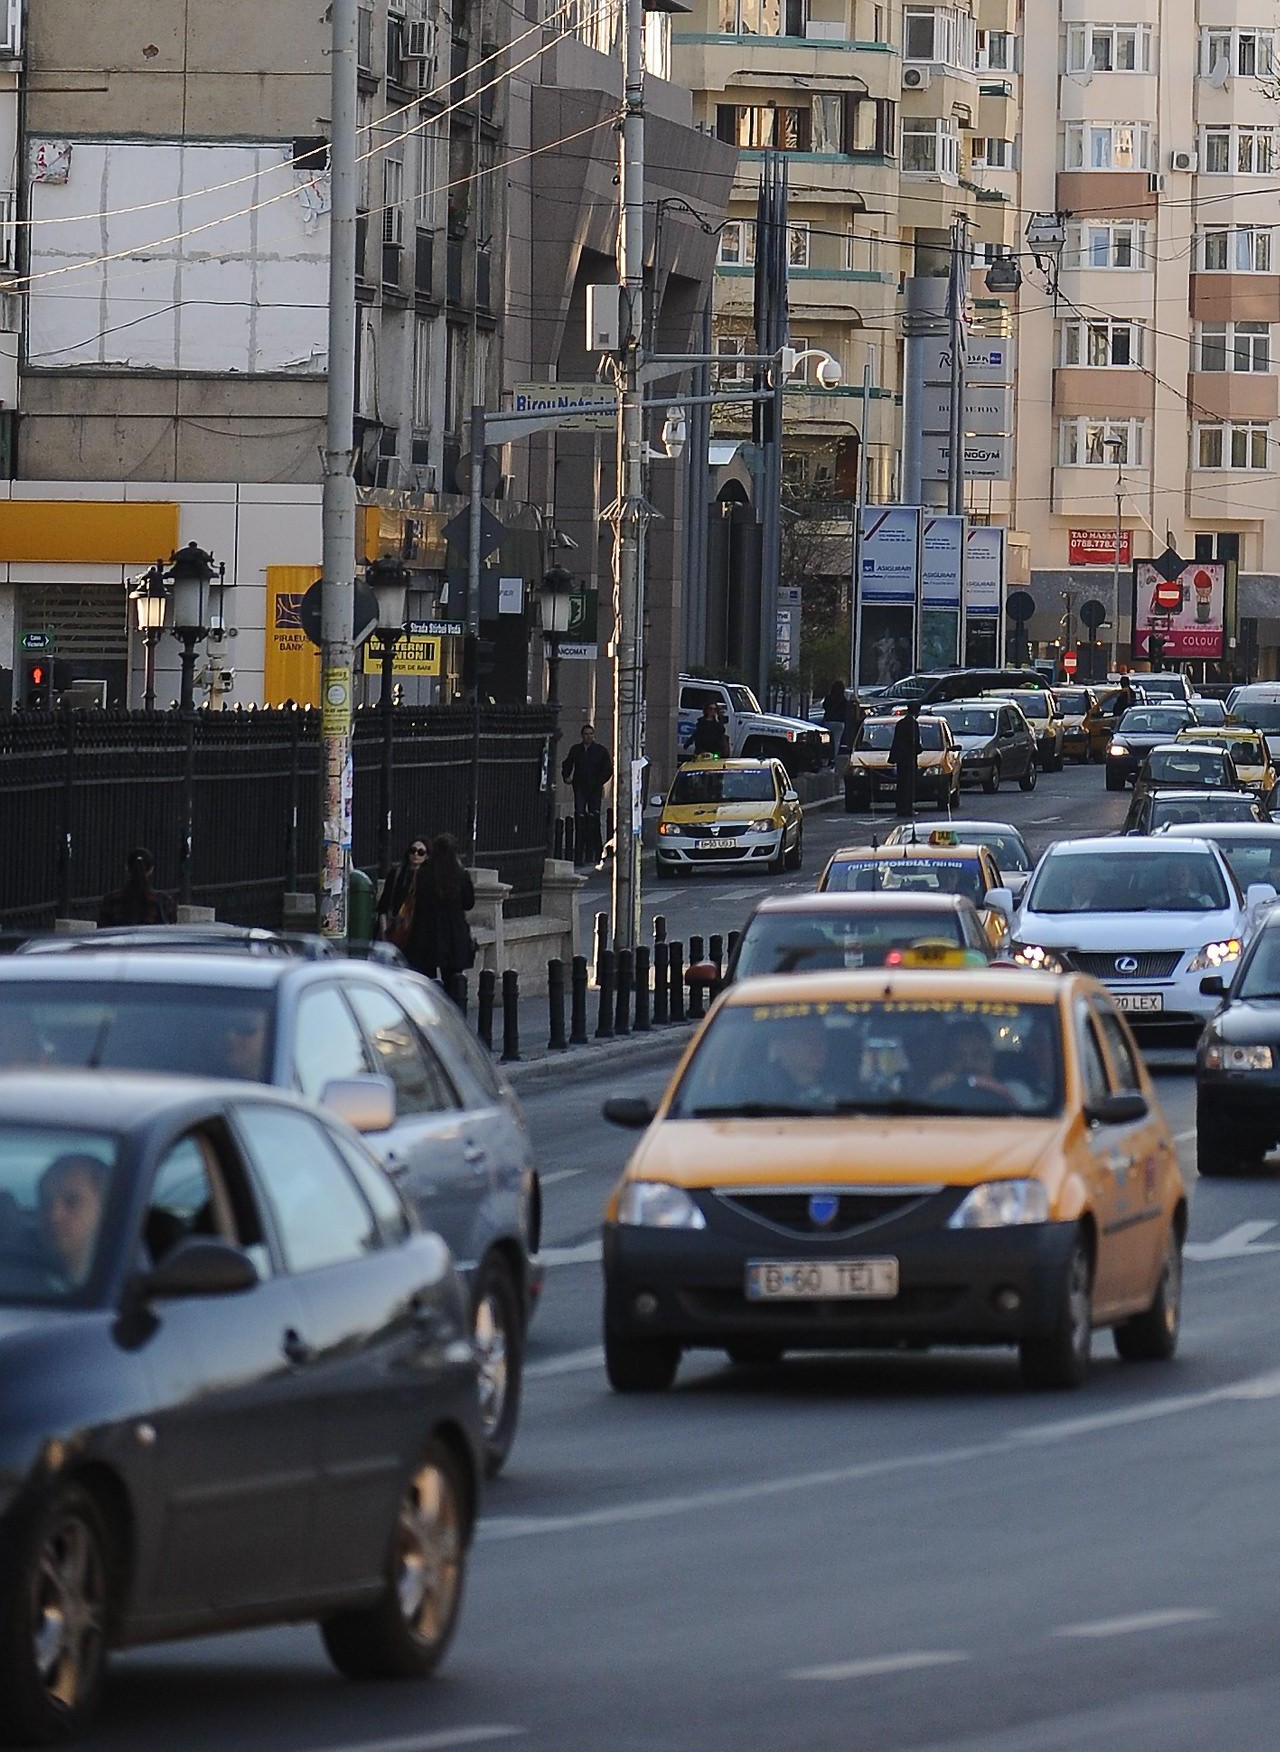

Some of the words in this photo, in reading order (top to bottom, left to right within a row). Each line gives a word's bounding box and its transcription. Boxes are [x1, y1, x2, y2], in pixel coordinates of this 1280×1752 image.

[1071, 531, 1088, 539] TAO
[279, 643, 304, 651] BANK
[394, 651, 424, 660] NION
[879, 859, 931, 868] MONDIAL
[1133, 999, 1158, 1010] LEX
